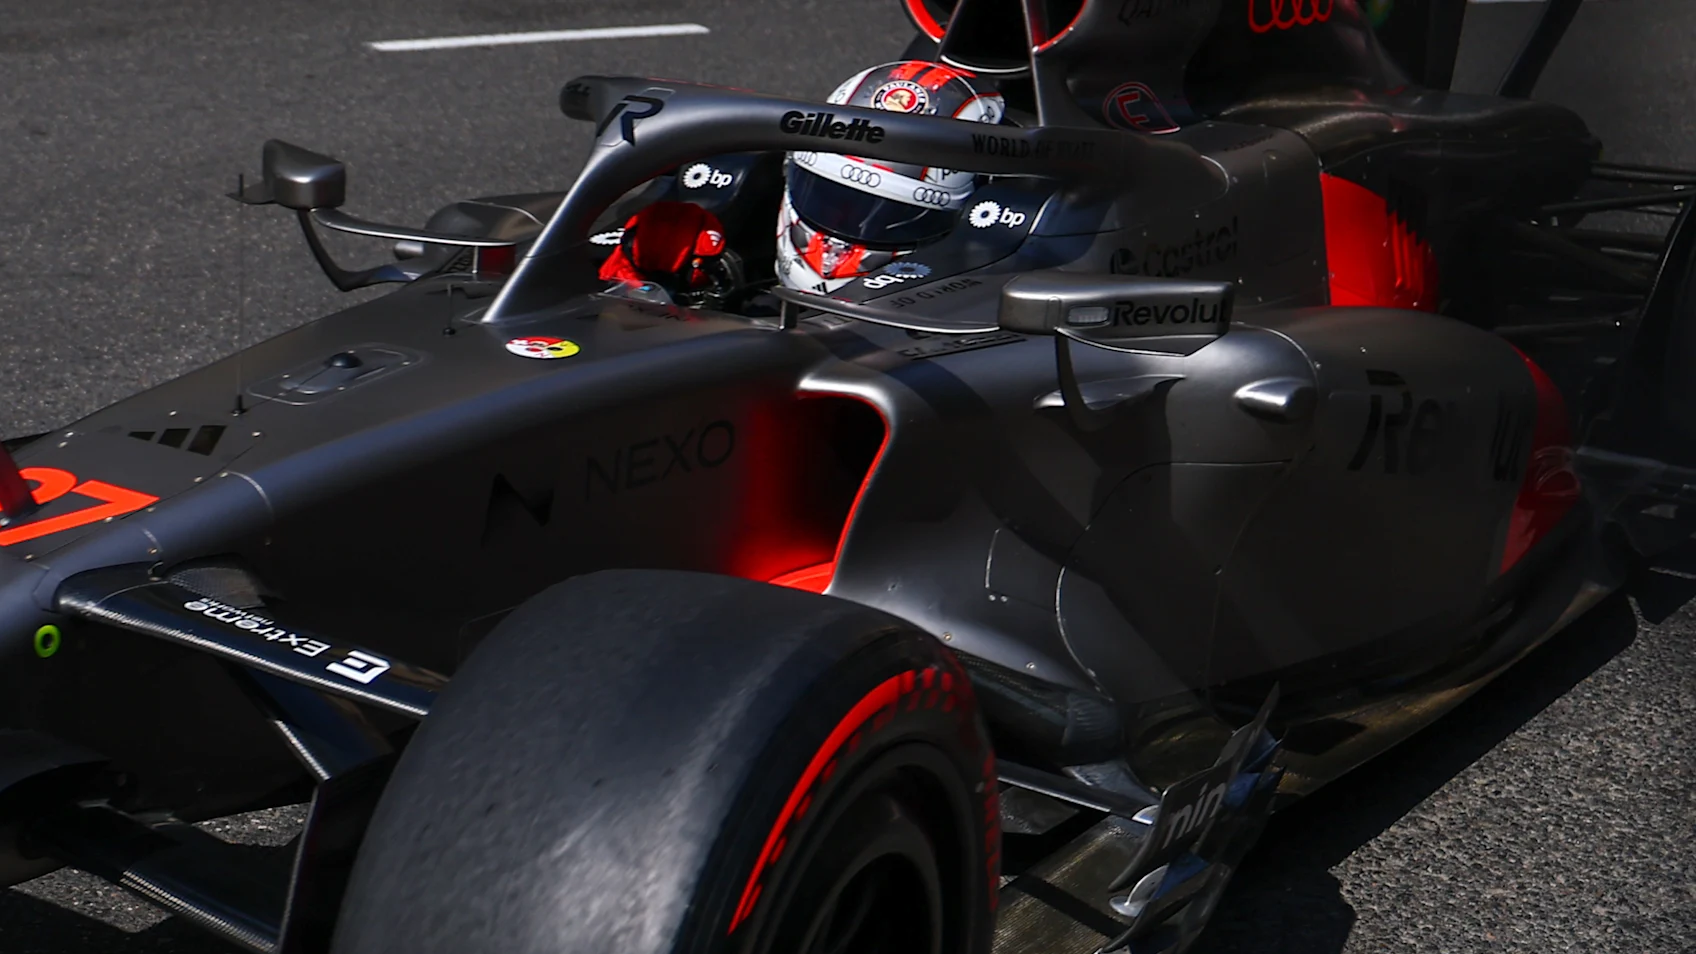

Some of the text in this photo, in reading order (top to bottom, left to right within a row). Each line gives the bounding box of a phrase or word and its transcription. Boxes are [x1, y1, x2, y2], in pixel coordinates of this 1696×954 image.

[779, 110, 886, 145] Gillette
[971, 133, 1031, 159] WORLD
[709, 167, 735, 189] bp
[998, 205, 1027, 229] bp
[1142, 215, 1239, 278] Castrol
[584, 419, 737, 501] NEXO
[182, 599, 332, 658] Extreme
